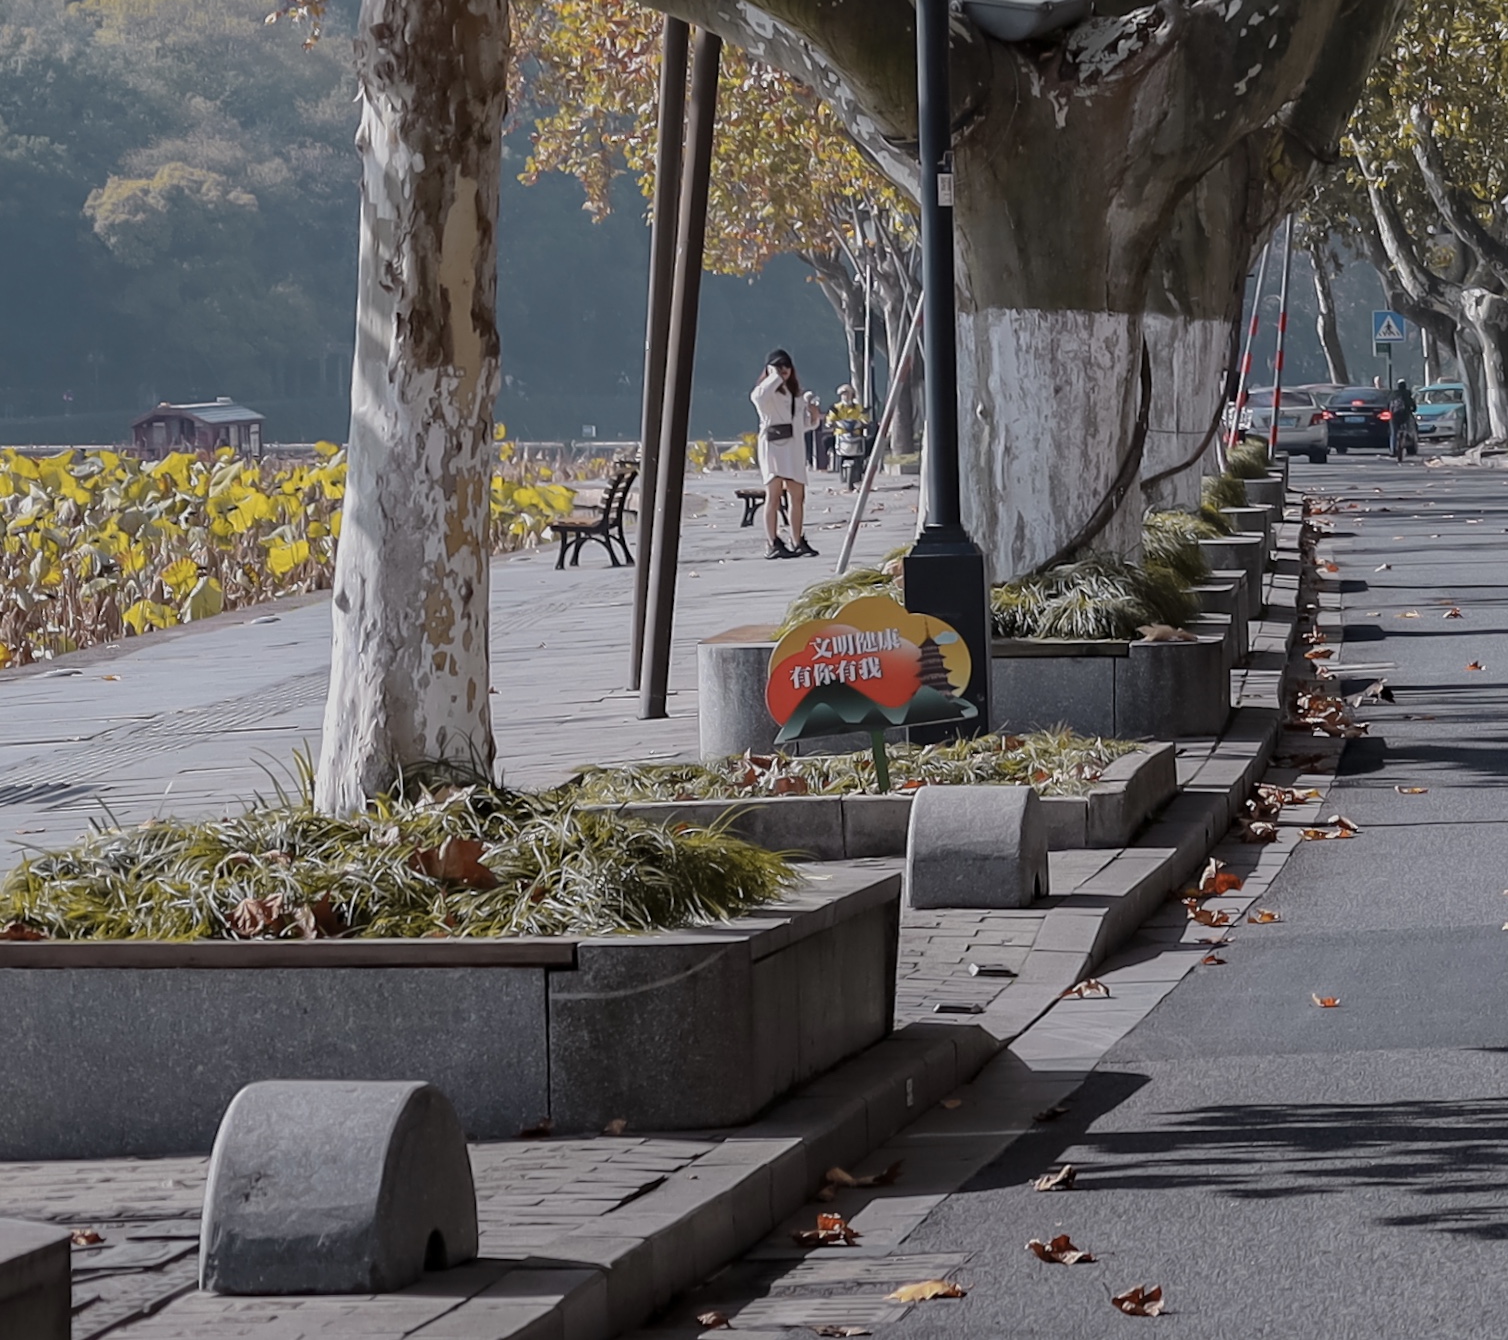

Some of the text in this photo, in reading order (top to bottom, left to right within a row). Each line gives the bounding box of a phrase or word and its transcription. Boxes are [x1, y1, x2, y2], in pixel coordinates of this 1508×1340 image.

[809, 628, 901, 661] 文明健康
[790, 657, 882, 689] 有你有我
